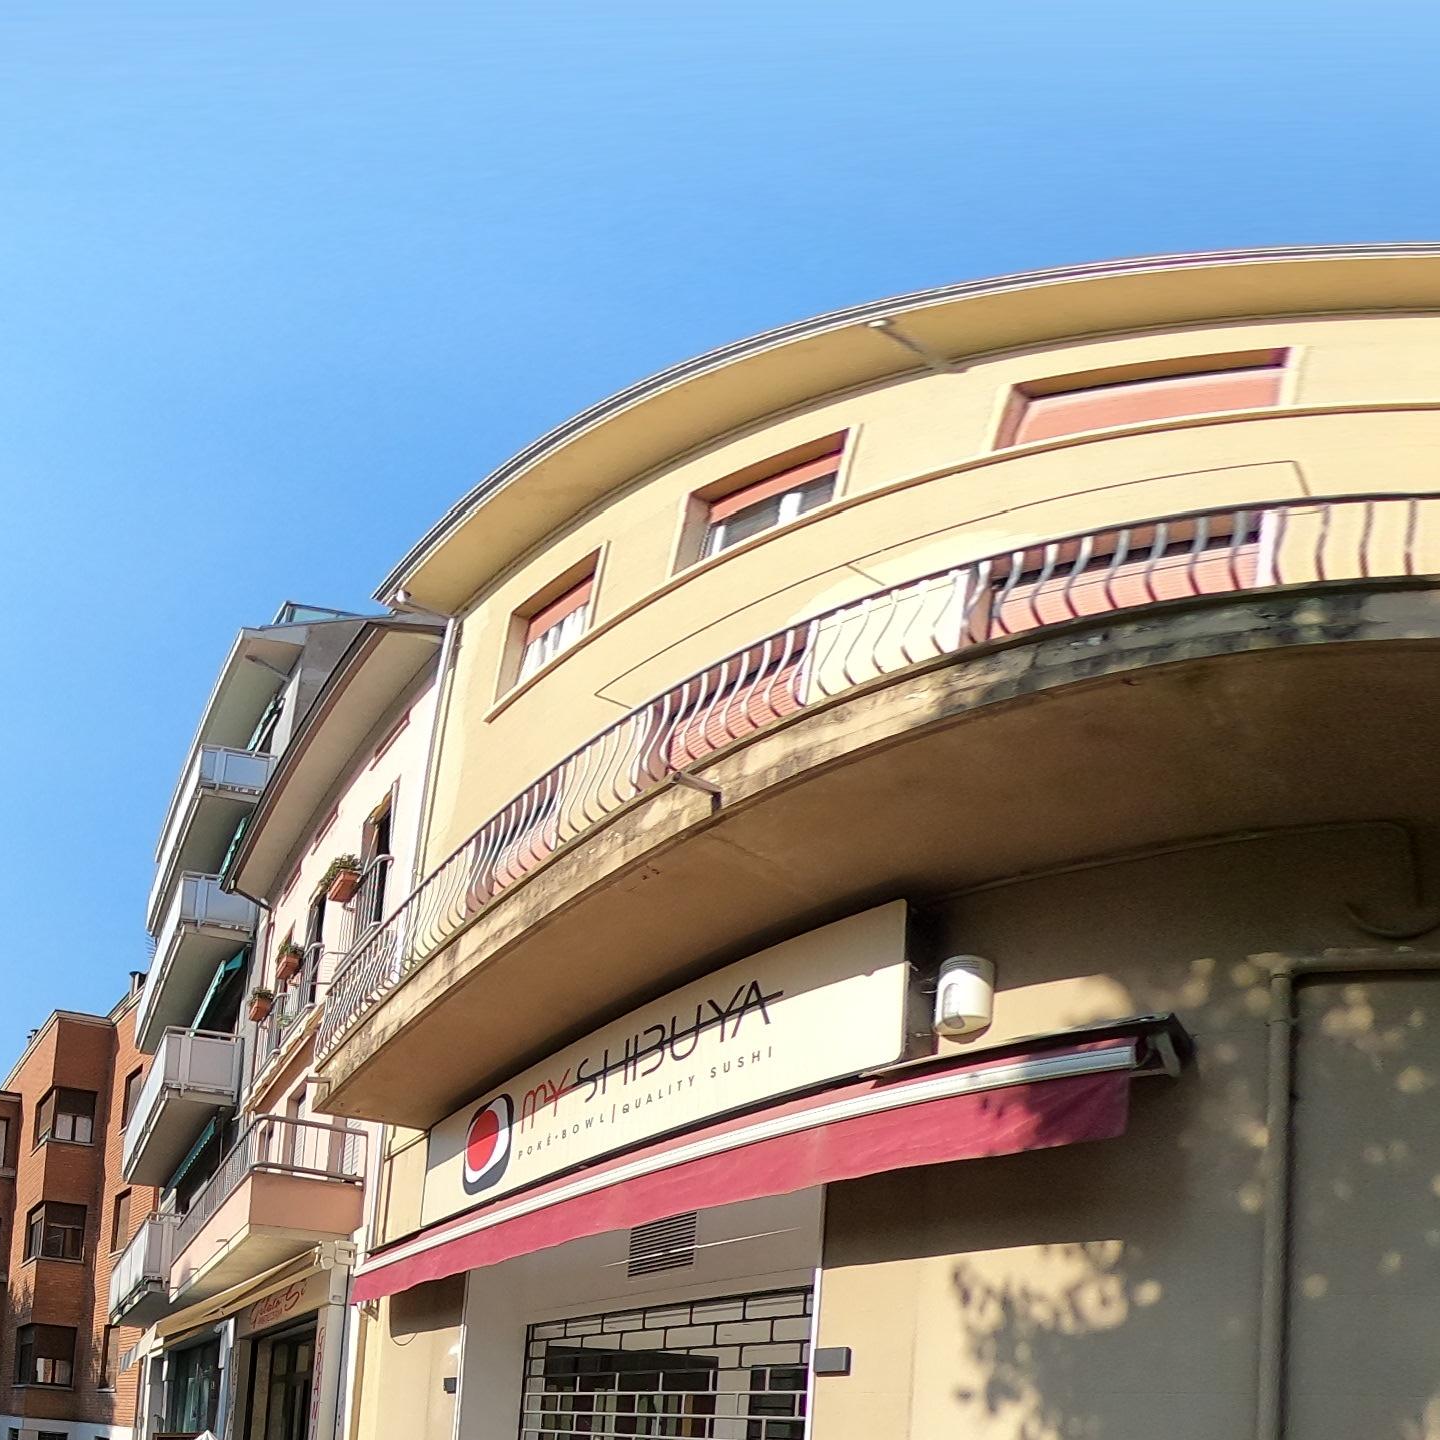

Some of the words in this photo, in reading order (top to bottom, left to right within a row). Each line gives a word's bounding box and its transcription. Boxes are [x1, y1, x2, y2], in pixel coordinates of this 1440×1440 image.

[576, 980, 783, 1103] SHIBUYA
[622, 1074, 696, 1115] QUALITY
[710, 1046, 773, 1079] SUSHI
